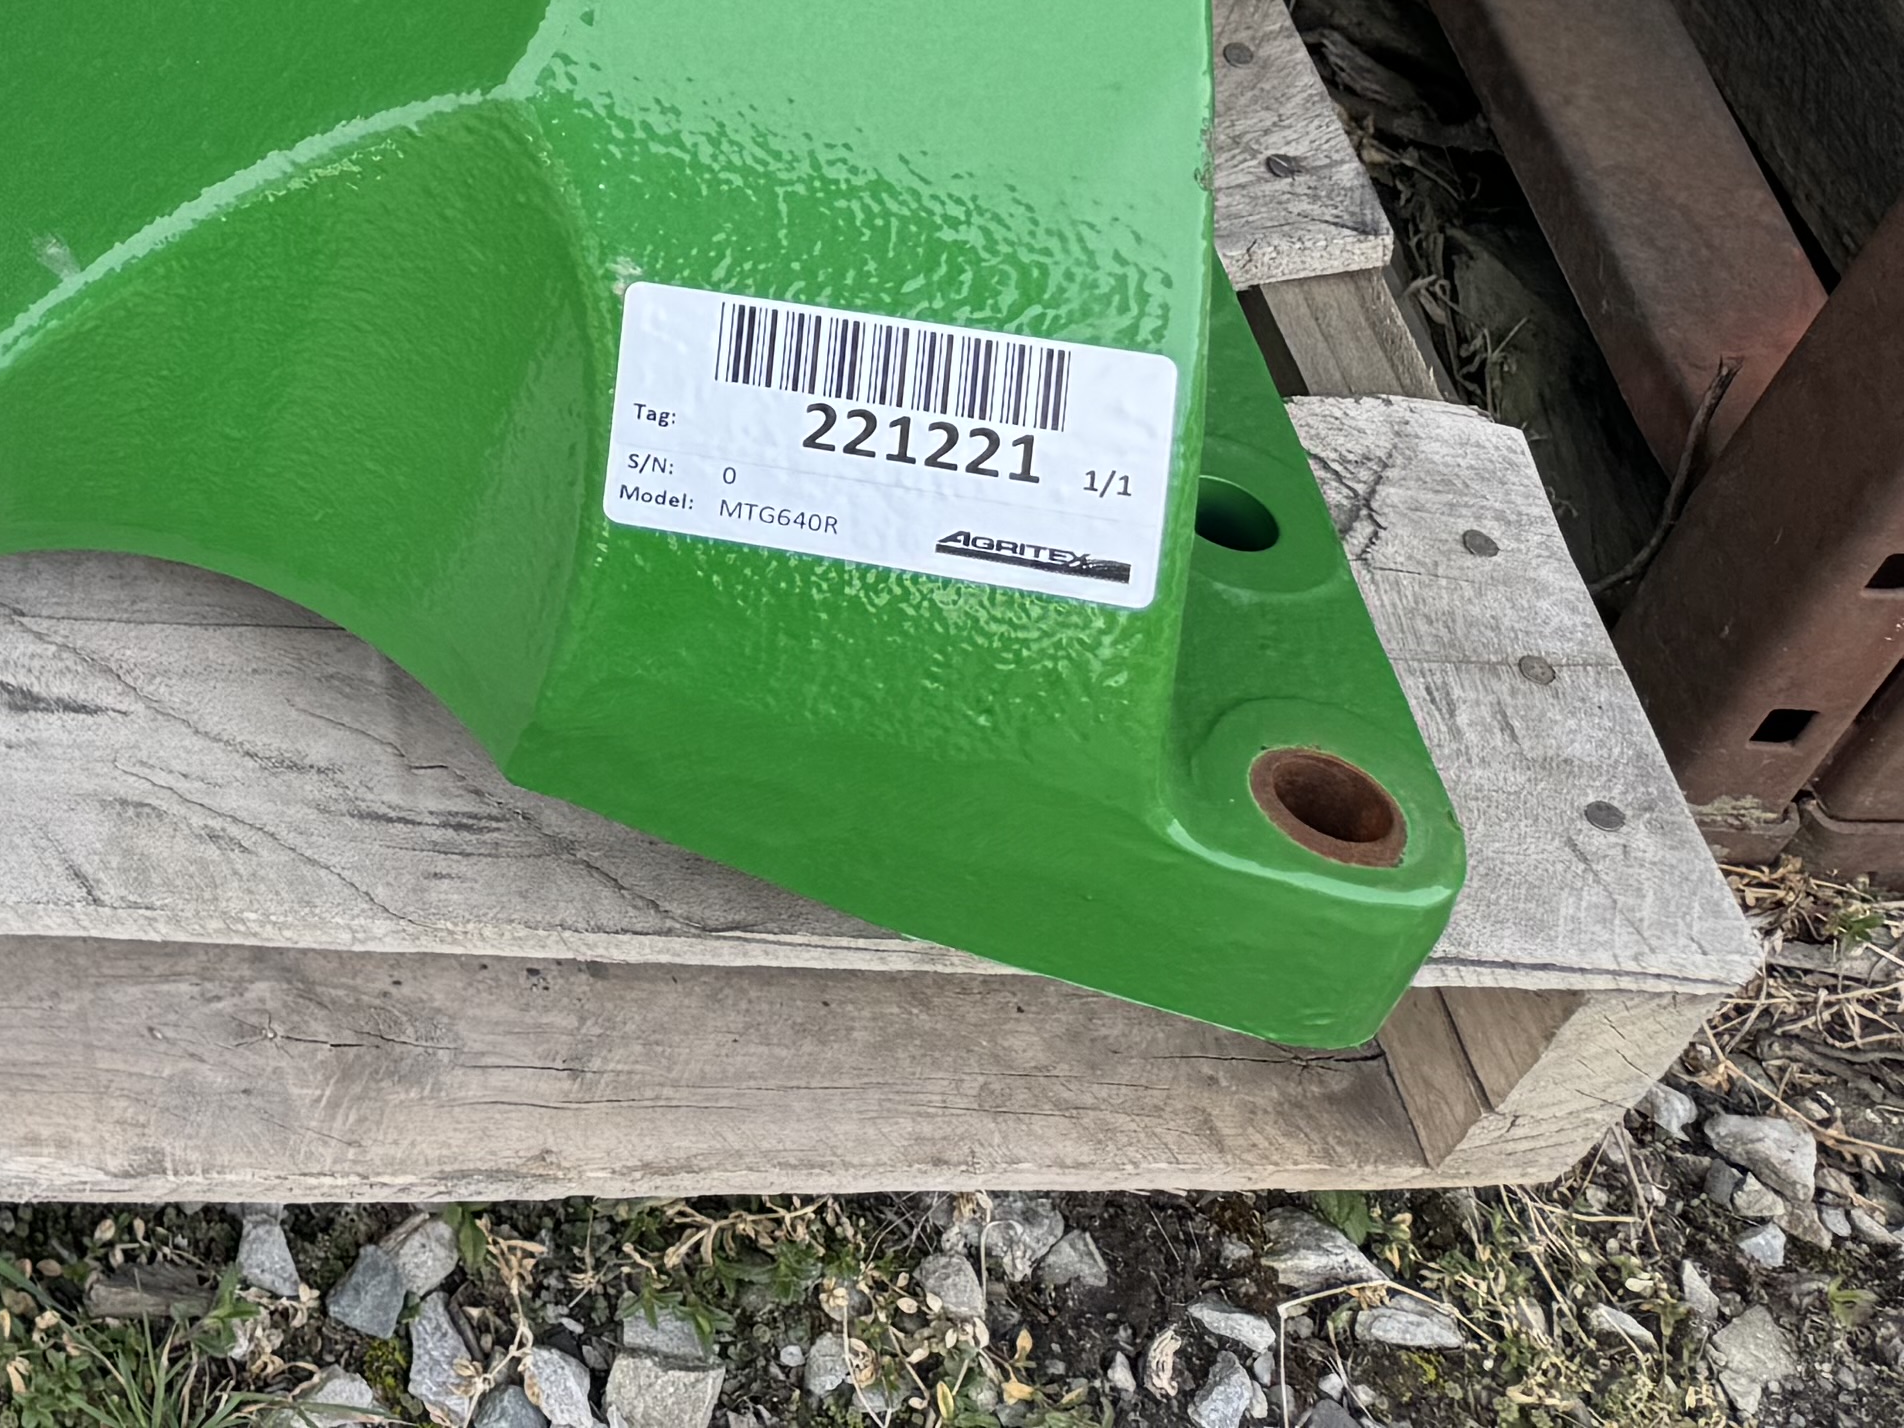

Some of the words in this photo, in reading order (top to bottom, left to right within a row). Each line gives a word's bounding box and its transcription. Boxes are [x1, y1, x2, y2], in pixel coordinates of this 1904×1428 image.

[626, 451, 675, 477] S/N:
[633, 401, 677, 428] Tag:
[800, 400, 1042, 486] 221221
[1082, 469, 1133, 500] 1/1
[619, 483, 695, 513] Model:
[718, 498, 839, 536] MTG640R
[936, 528, 1092, 570] AGRITEX
